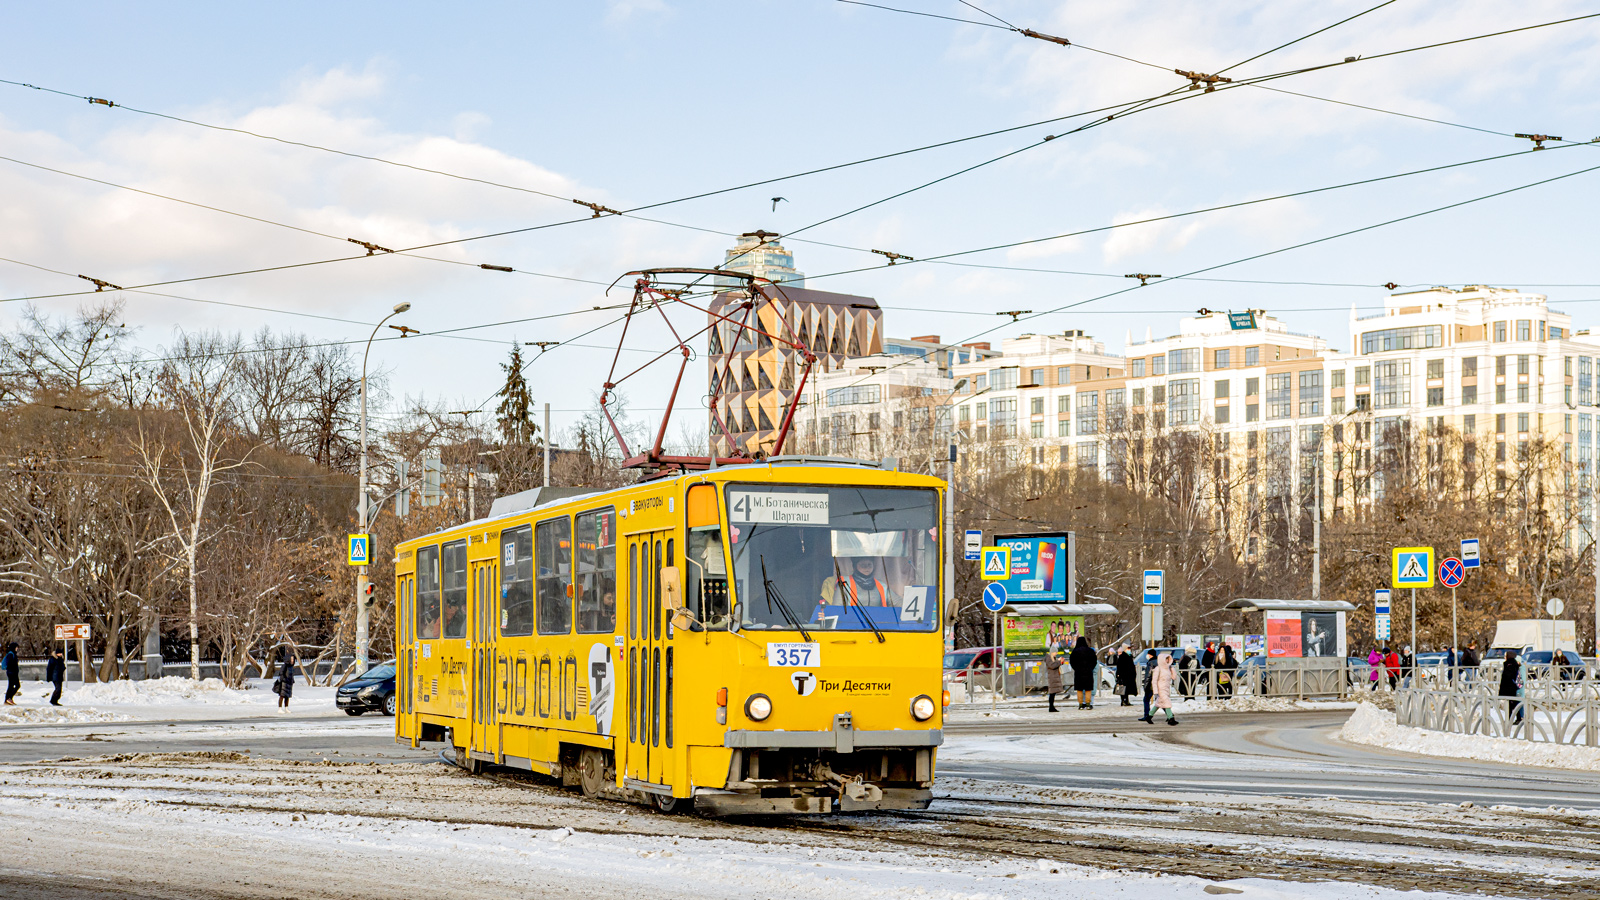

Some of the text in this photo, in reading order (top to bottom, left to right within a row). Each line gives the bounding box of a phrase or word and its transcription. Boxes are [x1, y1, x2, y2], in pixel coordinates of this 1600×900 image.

[733, 494, 829, 522] 4 М. Ботаническая
[772, 510, 810, 523] Шарташ
[505, 543, 515, 561] 357
[904, 595, 920, 618] 4
[1006, 619, 1016, 629] 23
[776, 648, 812, 666] 357
[440, 656, 449, 678] Три
[819, 679, 891, 693] Три Десятки
